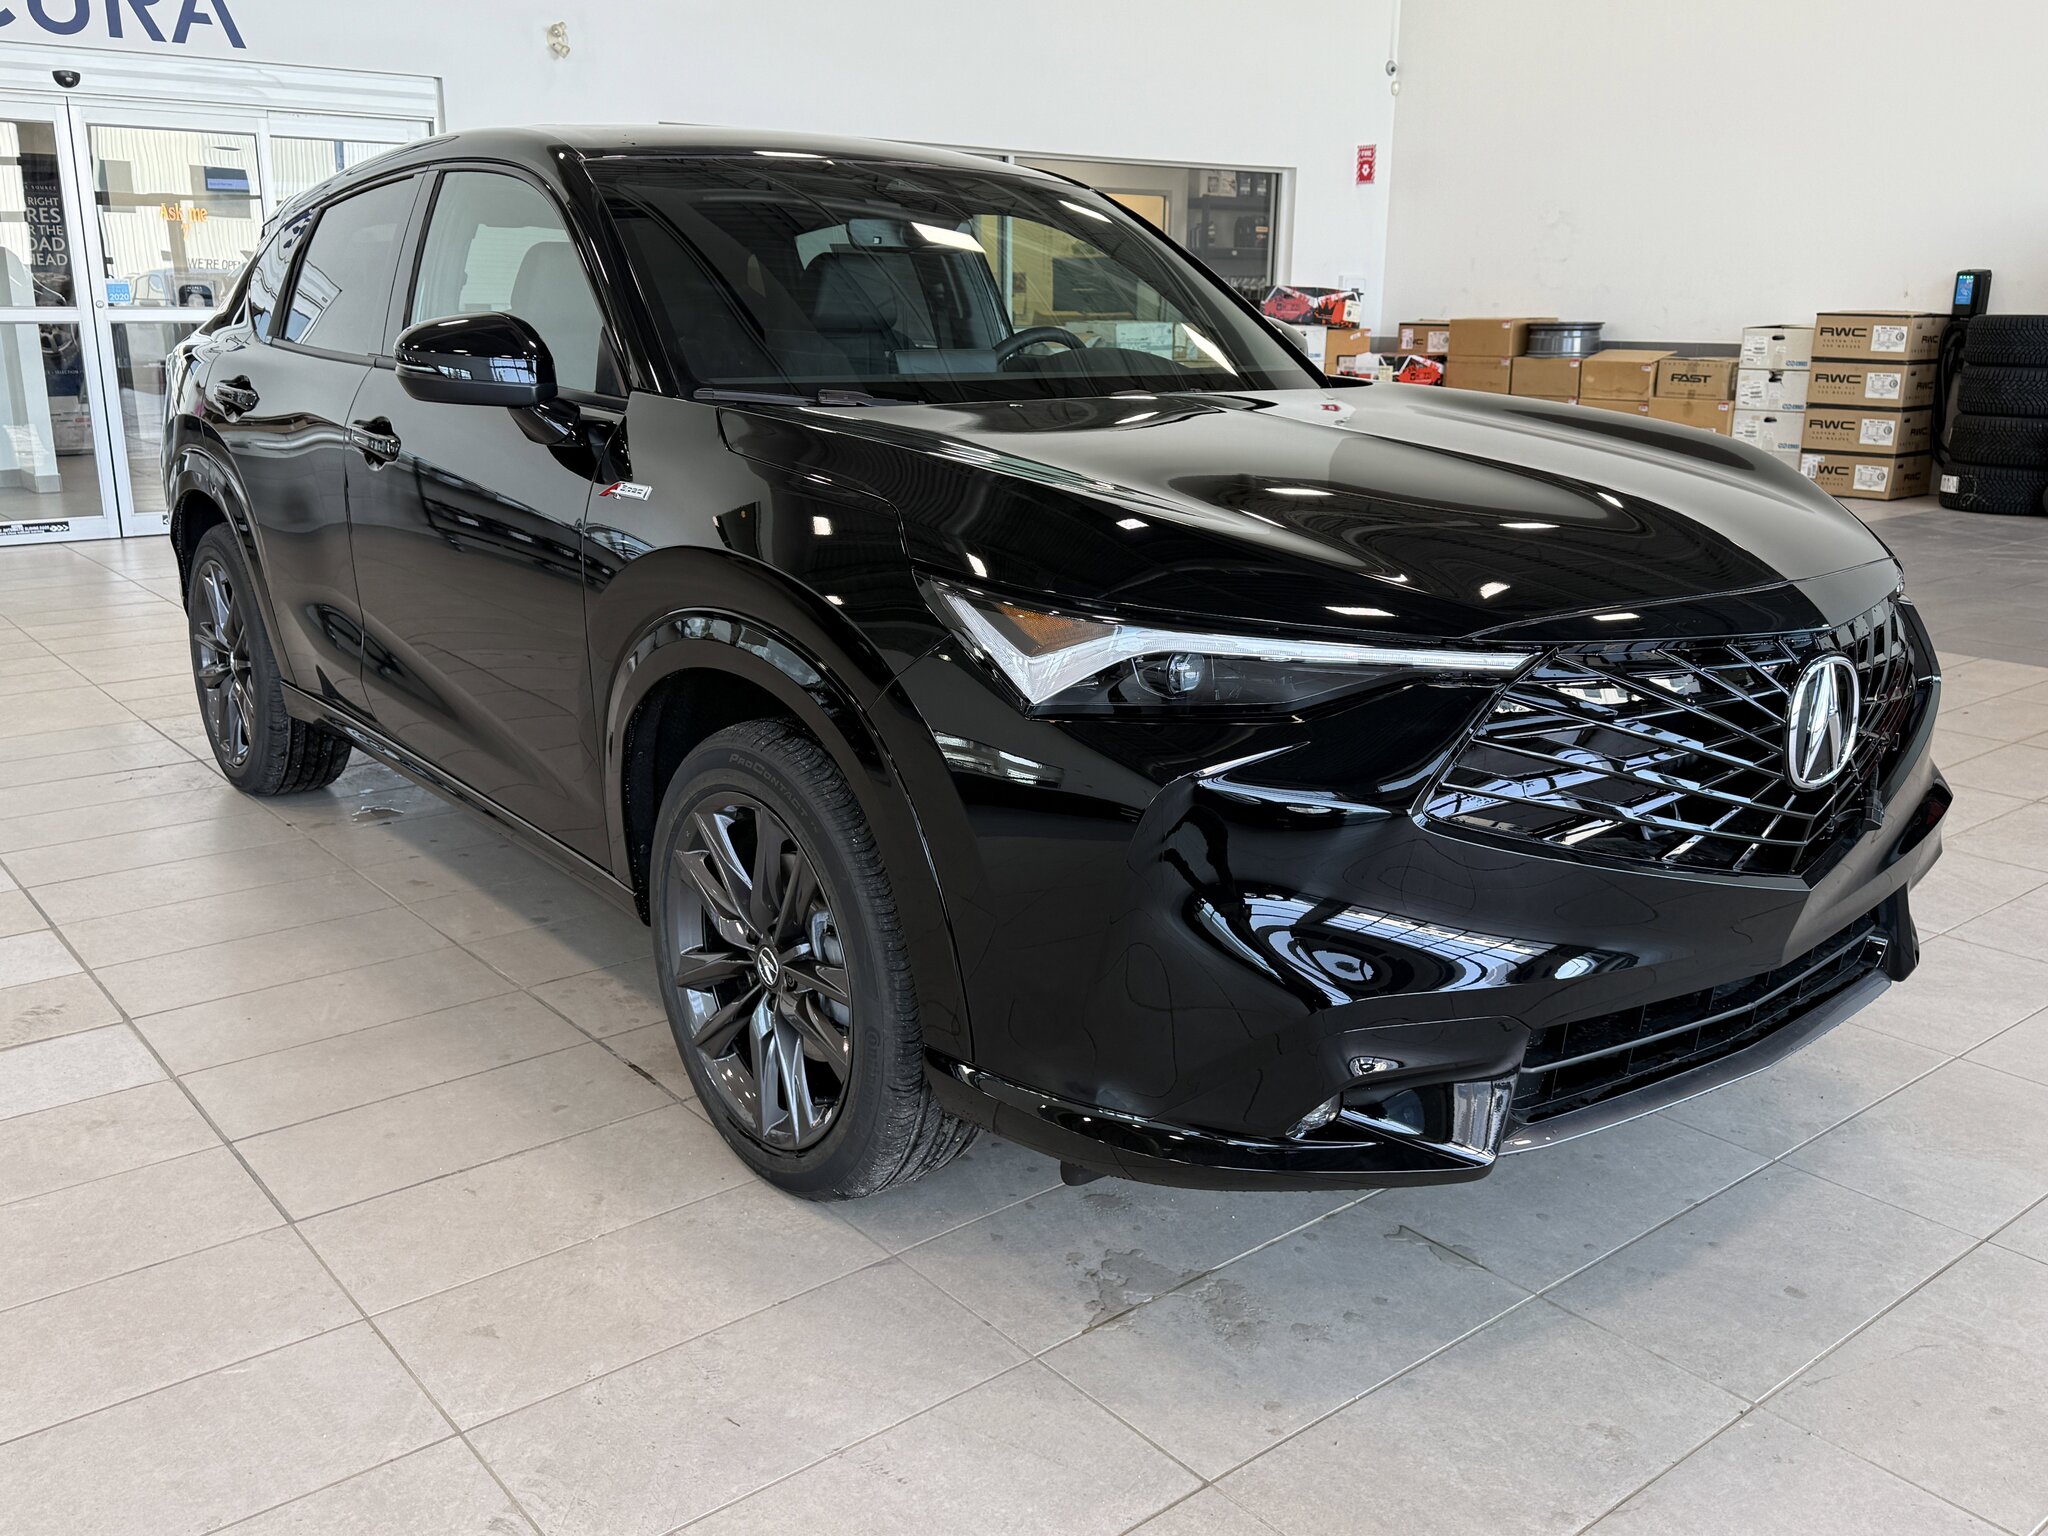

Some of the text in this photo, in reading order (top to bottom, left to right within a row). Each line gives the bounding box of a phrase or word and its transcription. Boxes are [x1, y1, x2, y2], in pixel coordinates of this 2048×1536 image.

[27, 197, 58, 206] RIGHT
[26, 207, 61, 223] RES
[160, 202, 208, 223] Ask me
[37, 225, 64, 235] THE
[30, 237, 66, 251] OAD
[188, 258, 240, 270] WE'RE OPE
[109, 293, 129, 301] 2020
[1671, 373, 1712, 384] FAST
[1818, 465, 1850, 476] WC
